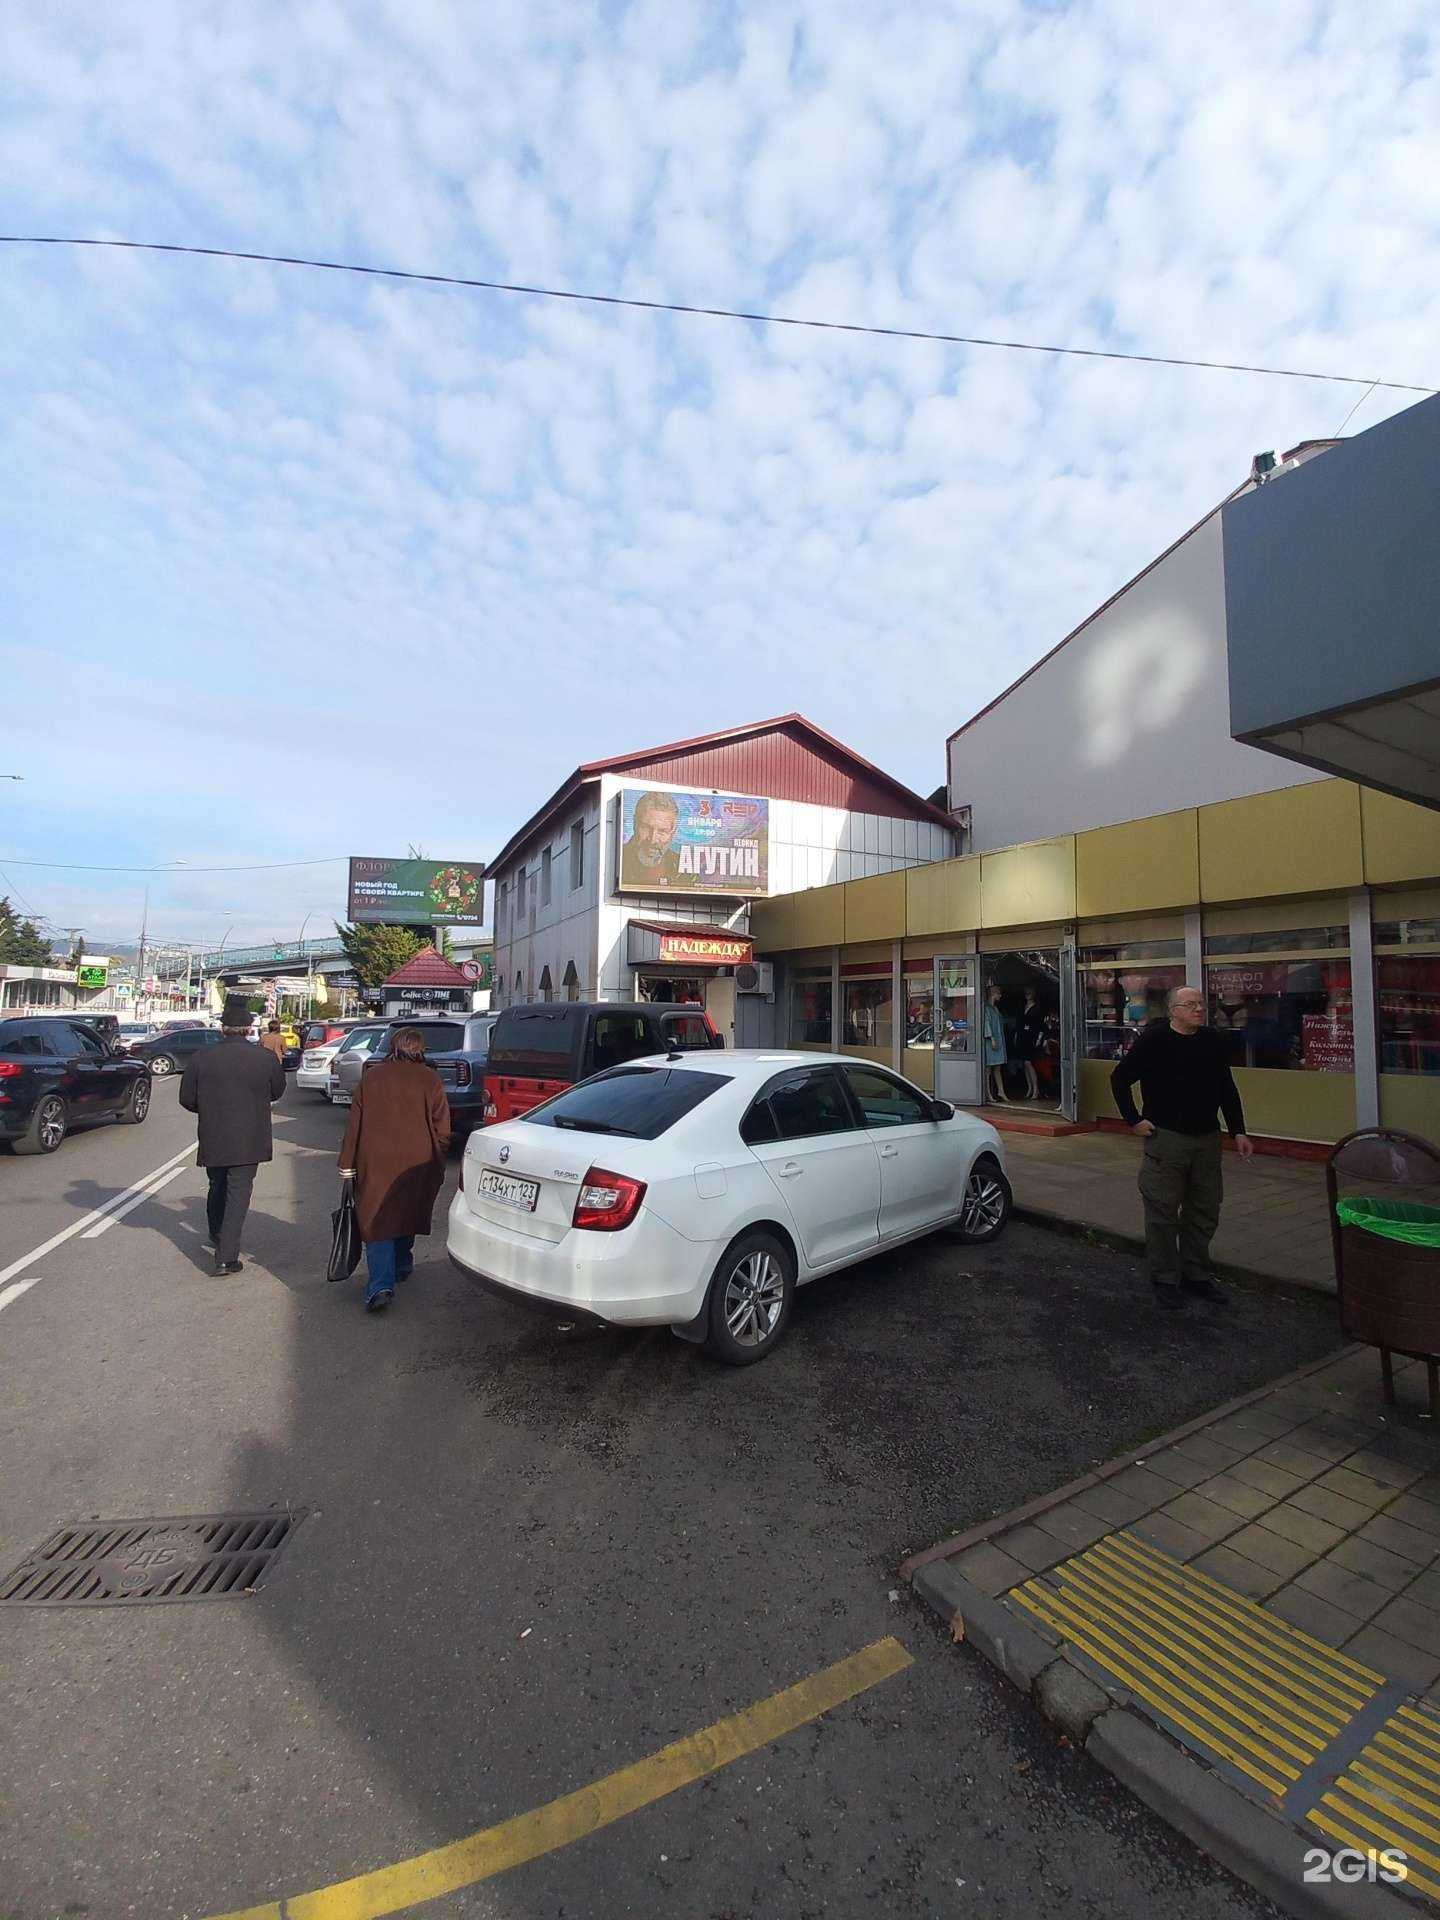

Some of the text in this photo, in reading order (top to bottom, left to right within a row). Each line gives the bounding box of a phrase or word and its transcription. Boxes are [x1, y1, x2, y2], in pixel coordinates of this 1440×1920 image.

[699, 800, 711, 816] 3
[687, 817, 722, 828] ЯНВАРЯ
[678, 845, 760, 877] АГУТИН
[354, 880, 398, 890] НОВЫЙ ГОД
[361, 888, 386, 896] СВОЕЙ
[401, 990, 451, 1000] Coffee TIME
[1306, 1021, 1346, 1031] Нижнее
[518, 1185, 535, 1199] 123
